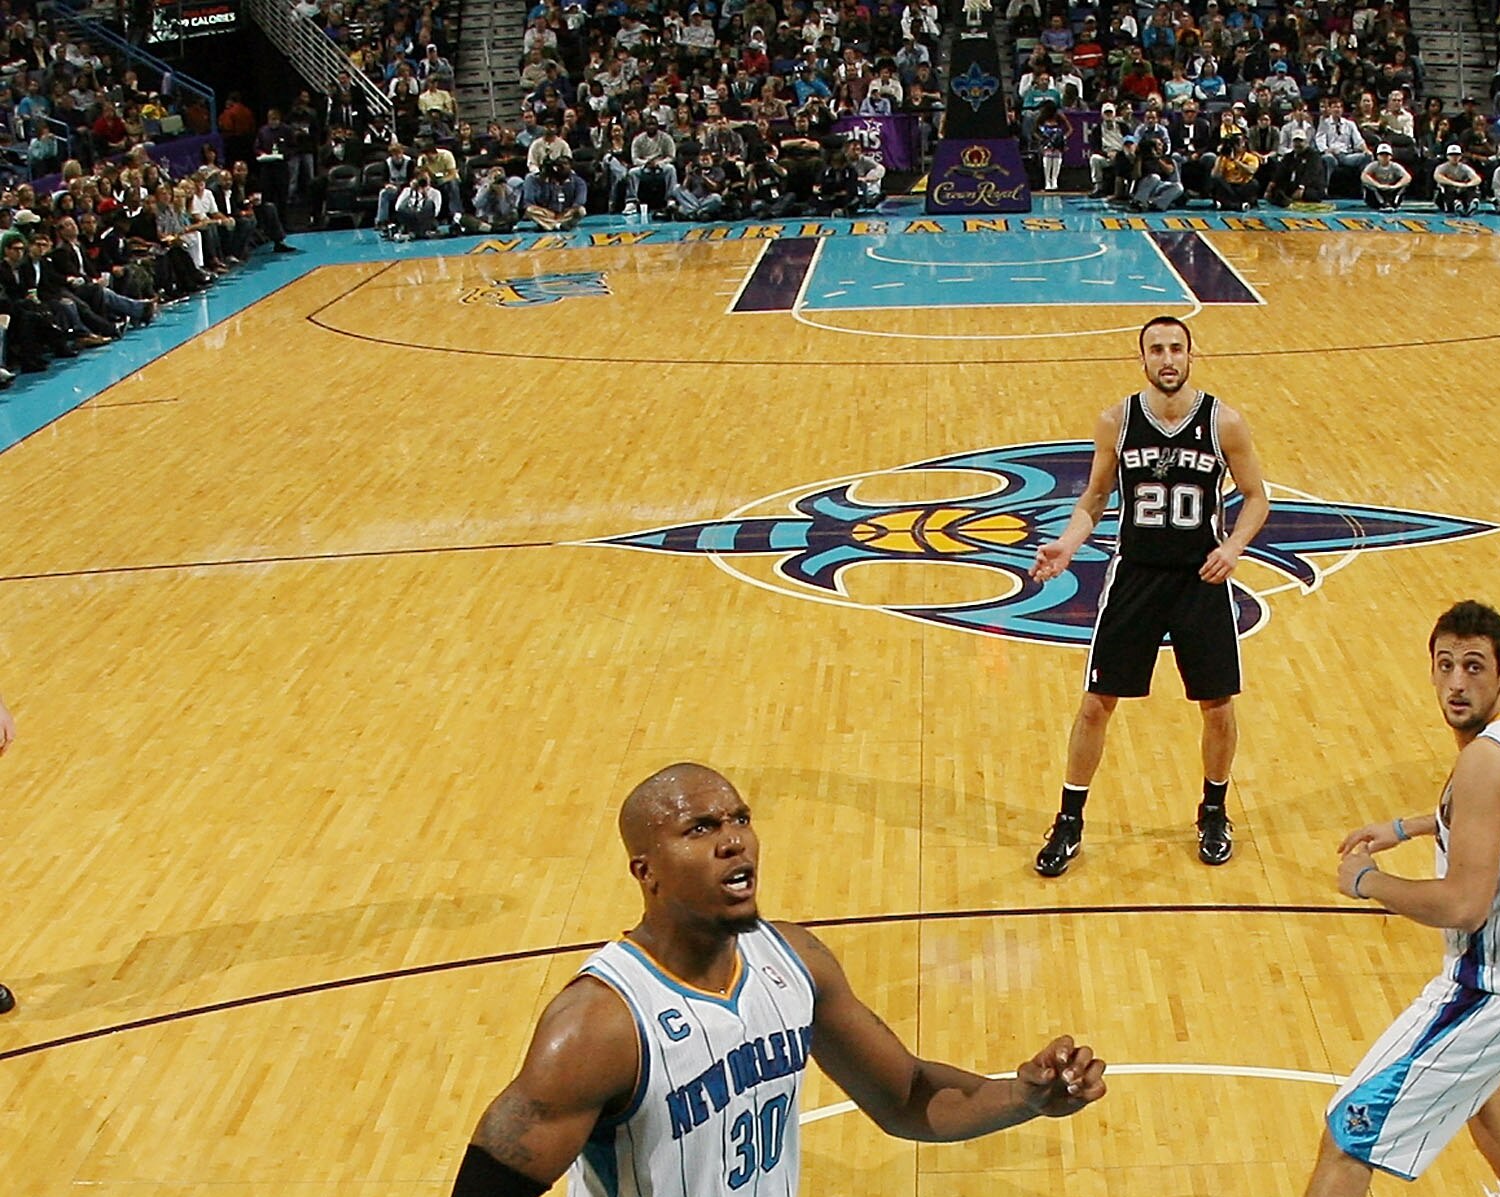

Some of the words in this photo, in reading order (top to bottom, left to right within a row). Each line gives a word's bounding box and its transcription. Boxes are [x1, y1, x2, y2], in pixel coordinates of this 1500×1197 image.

[933, 181, 977, 206] Crown
[963, 181, 1025, 206] Royal
[682, 216, 1068, 242] ORLEANS
[1100, 216, 1496, 235] HORNETS
[1122, 447, 1217, 476] SPURS
[1133, 482, 1204, 530] 20
[657, 1008, 691, 1042] C
[665, 1058, 731, 1141] NEW
[727, 1092, 794, 1191] 30
